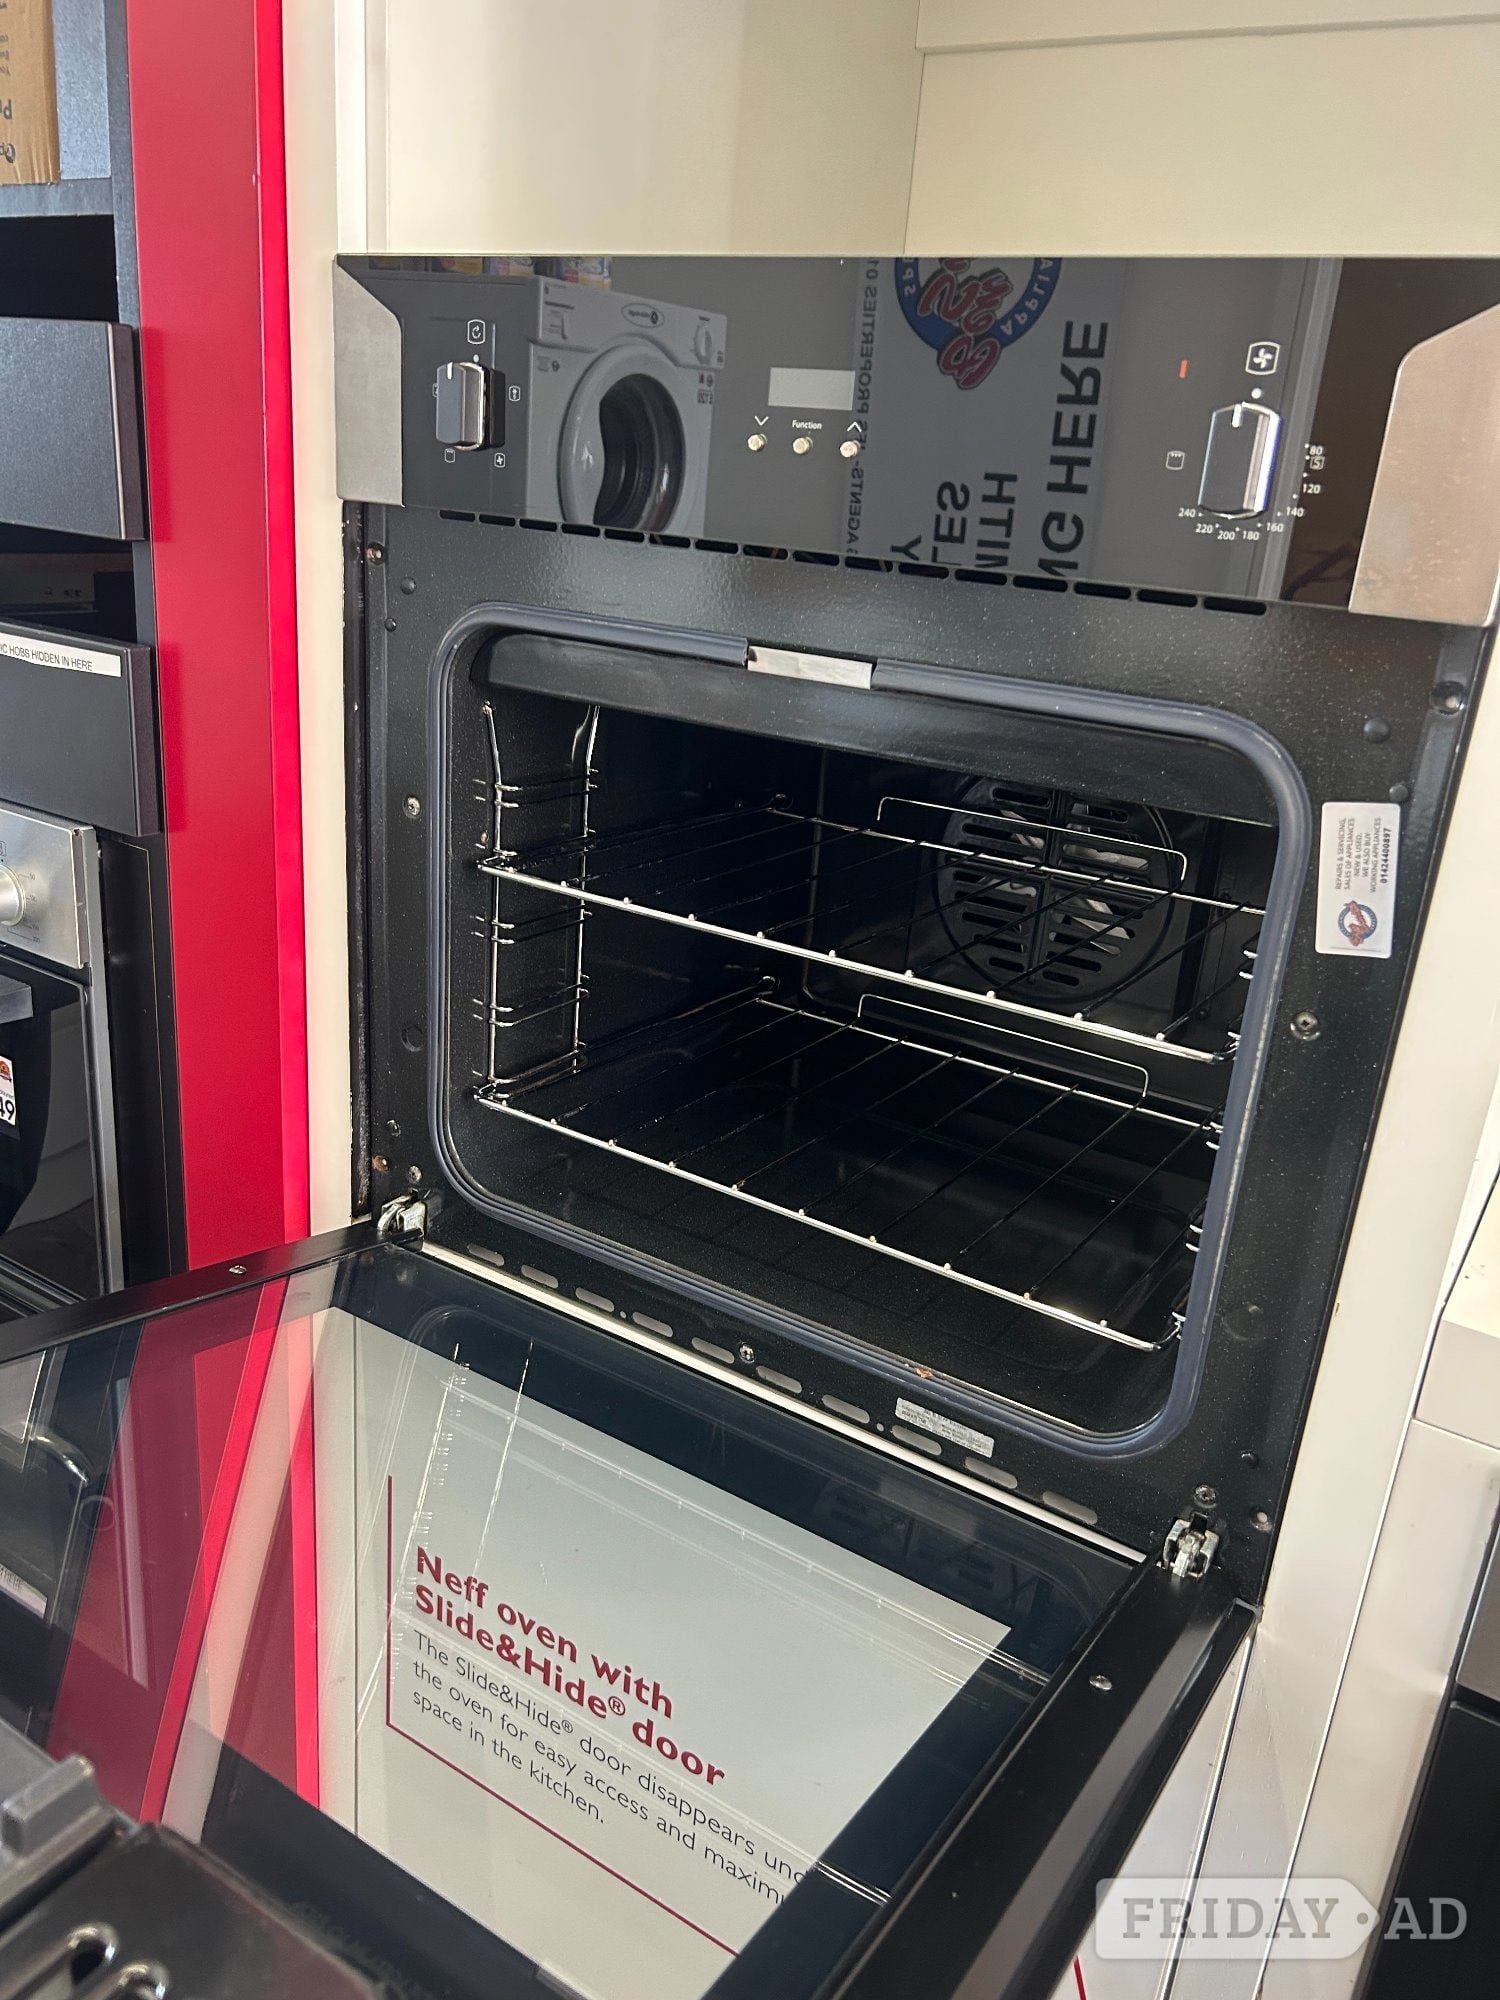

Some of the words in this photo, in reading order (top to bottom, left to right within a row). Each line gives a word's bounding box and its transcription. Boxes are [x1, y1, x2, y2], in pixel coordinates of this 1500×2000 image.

[792, 419, 822, 430] Function
[1309, 445, 1323, 455] 80
[1302, 483, 1321, 494] 120
[1178, 507, 1196, 518] 240
[1286, 506, 1304, 517] 140
[1195, 523, 1214, 534] 220
[1217, 530, 1235, 540] 200
[1242, 530, 1259, 540] 180
[1266, 522, 1284, 533] 160
[0, 643, 8, 654] IC
[9, 644, 30, 658] HOBS
[31, 650, 60, 664] HIDDEN
[62, 656, 70, 666] IN
[71, 658, 93, 671] HERE
[1346, 818, 1355, 858] APPLIANCES
[1363, 832, 1371, 847] BUY
[1371, 817, 1381, 858] APPLIANCES
[1362, 848, 1370, 866] ALSO
[1380, 827, 1391, 884] 01424400897
[1345, 860, 1351, 869] OF
[1362, 867, 1369, 877] WE
[1335, 863, 1343, 890] REPAIRS
[1370, 860, 1379, 893] WORKING
[417, 1545, 489, 1609] Neff
[498, 1602, 578, 1664] oven
[591, 1655, 673, 1717] with
[415, 1584, 625, 1721] Slide&Hide®
[633, 1716, 726, 1787] door
[414, 1630, 449, 1666] The
[456, 1655, 574, 1736] Slide&Hide®
[580, 1734, 632, 1778] door
[638, 1772, 755, 1856] disappears
[413, 1692, 463, 1734] space
[470, 1721, 484, 1748] in
[492, 1734, 523, 1771] the
[530, 1759, 605, 1824] kitchen.
[413, 1658, 443, 1692] the
[449, 1685, 494, 1726] oven
[500, 1711, 529, 1745] for
[535, 1735, 577, 1777] easy
[585, 1771, 648, 1820] access
[657, 1817, 696, 1850] and
[704, 1846, 787, 1905] maxim
